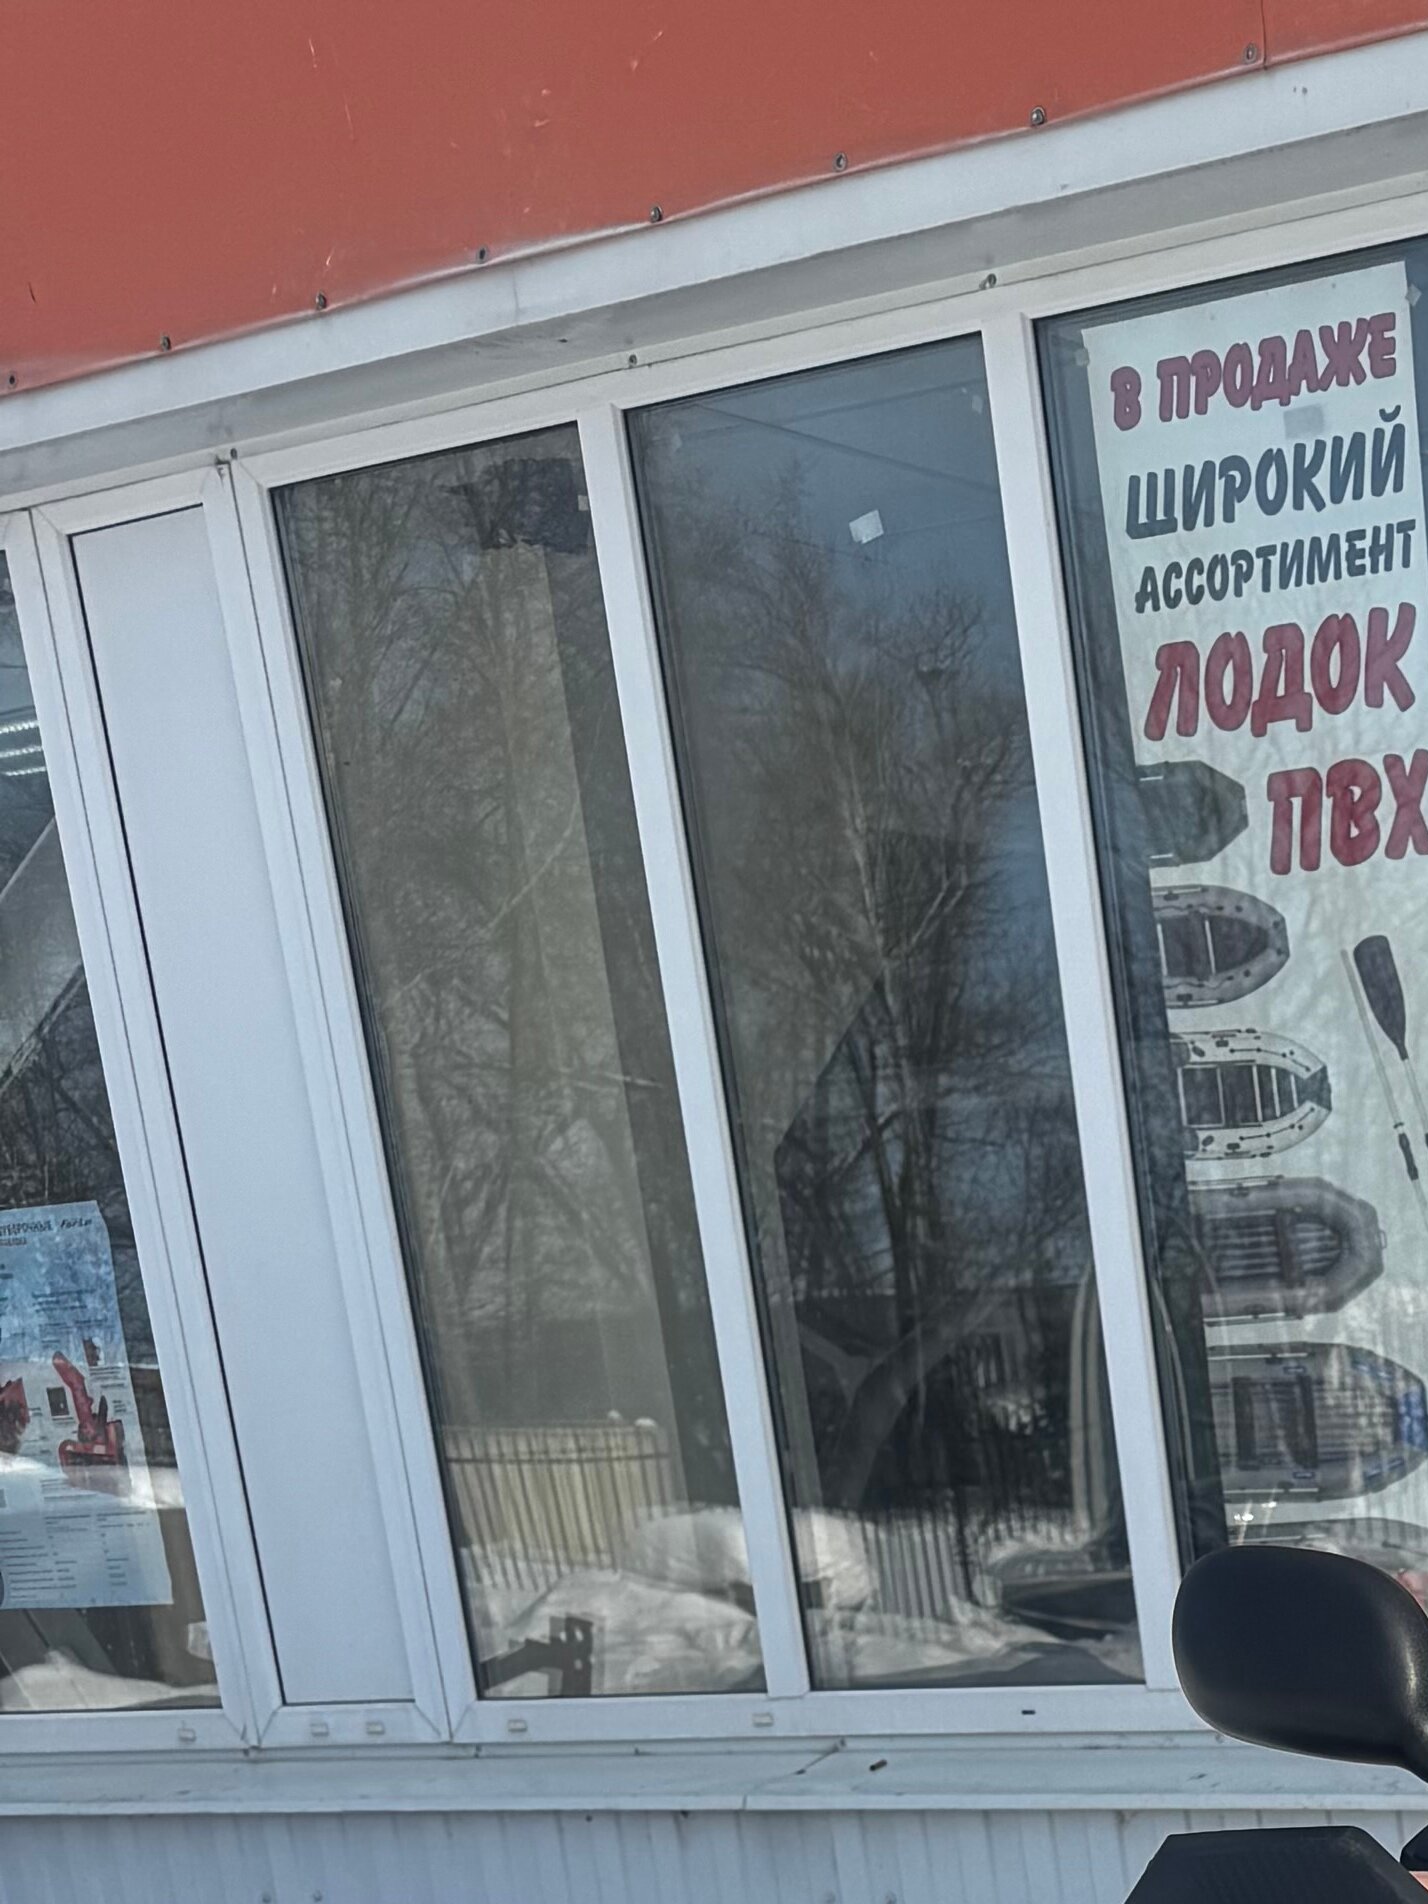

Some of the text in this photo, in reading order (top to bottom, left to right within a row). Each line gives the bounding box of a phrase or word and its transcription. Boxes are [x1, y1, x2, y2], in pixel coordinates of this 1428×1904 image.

[1110, 312, 1397, 431] В ПРОДАЖЕ
[1124, 405, 1406, 540] ШИРОКИЙ
[1135, 520, 1416, 614] АССОРТИМЕНТ
[1144, 602, 1417, 742] ЛОДОК
